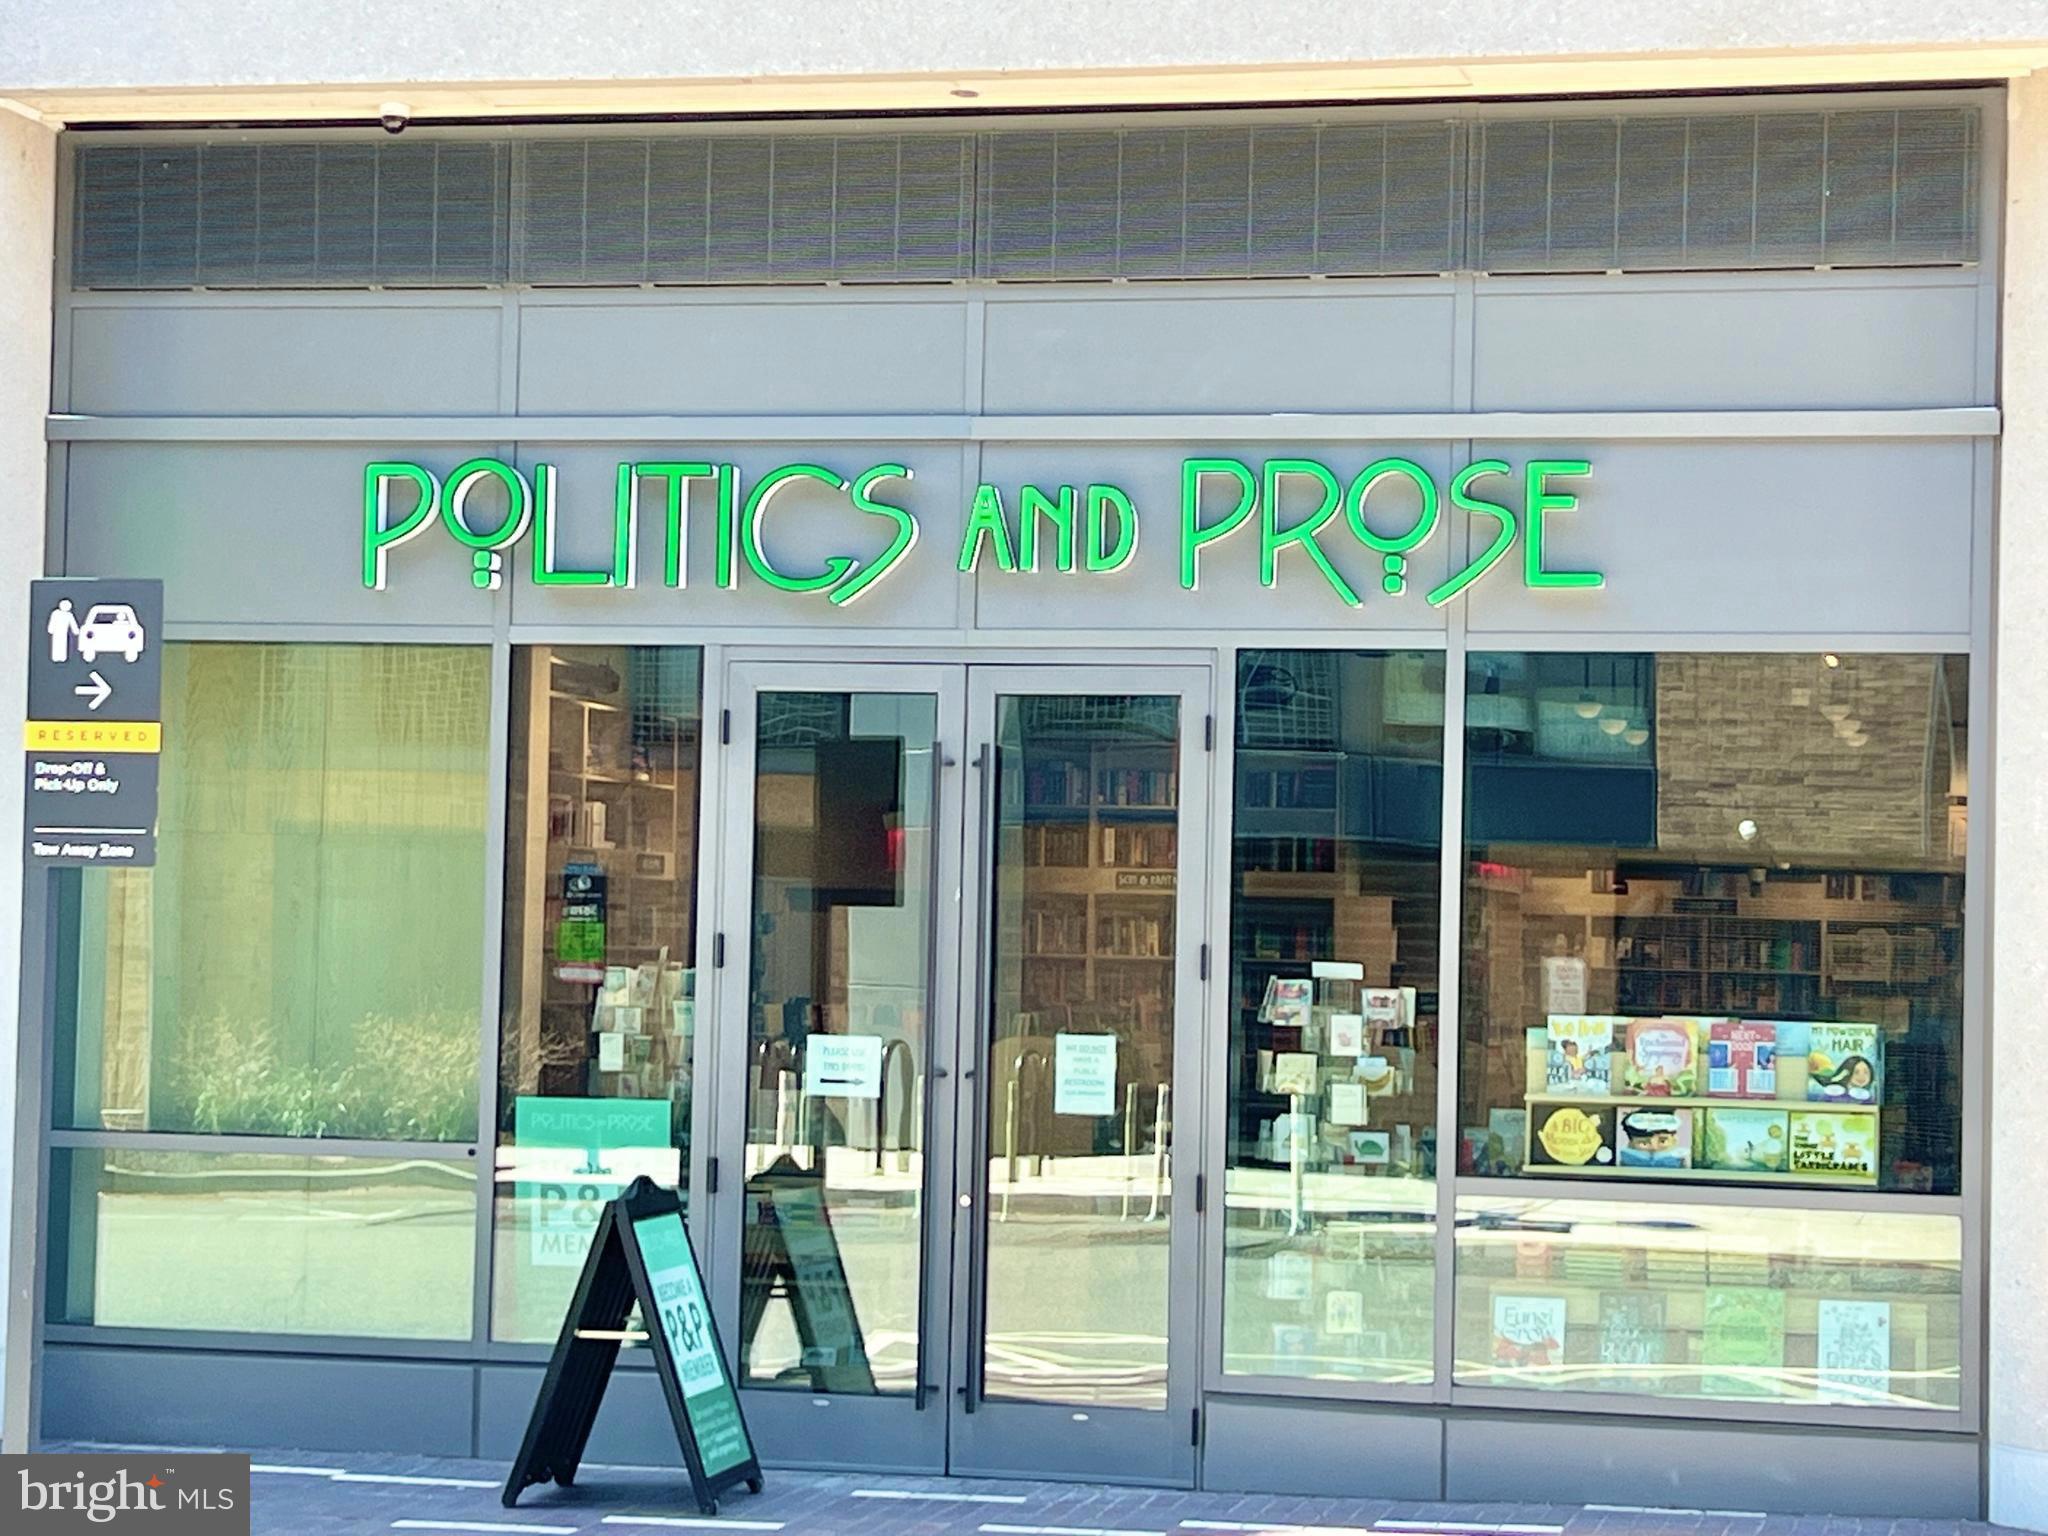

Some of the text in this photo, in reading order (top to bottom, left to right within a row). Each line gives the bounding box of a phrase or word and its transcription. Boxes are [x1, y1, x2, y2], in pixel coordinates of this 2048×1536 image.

[363, 457, 1605, 609] POLITICS AND PROSE
[37, 728, 148, 743] RESERVED
[34, 761, 106, 776] Drop-Off &
[86, 778, 119, 794] Only
[32, 841, 135, 859] Tow Away Zone
[1831, 1039, 1865, 1052] HAIR
[531, 1112, 594, 1131] POLITICS
[607, 1113, 655, 1132] PROSE
[1793, 1151, 1835, 1161] LITTLE
[664, 1301, 703, 1358] P&P
